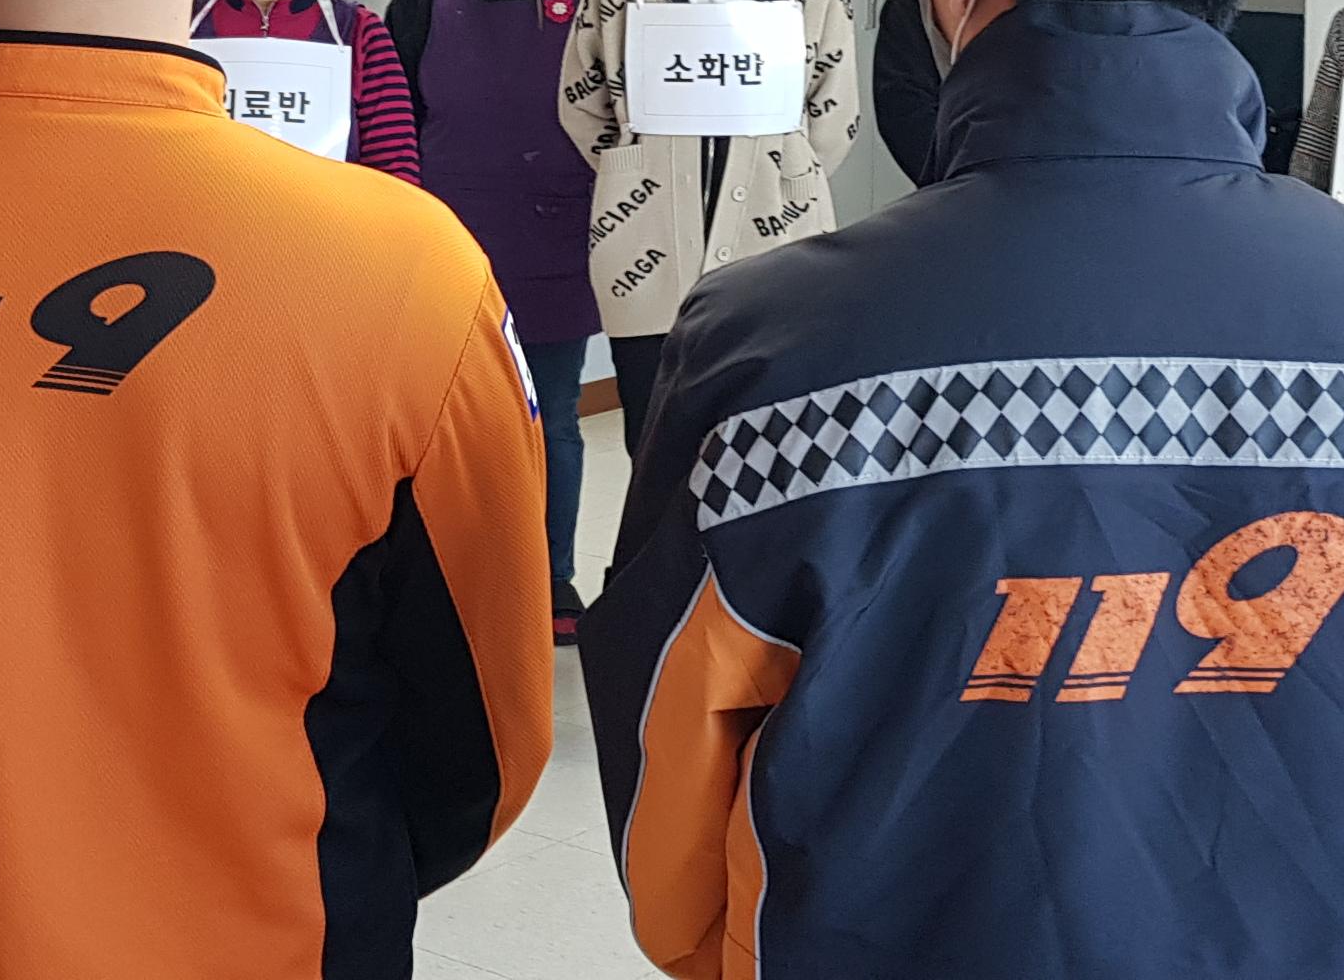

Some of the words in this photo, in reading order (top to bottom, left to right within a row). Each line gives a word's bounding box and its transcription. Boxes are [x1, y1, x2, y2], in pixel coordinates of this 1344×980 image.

[663, 52, 764, 87] 소화반
[590, 178, 662, 249] NCIAGA
[611, 249, 667, 297] CIAGA
